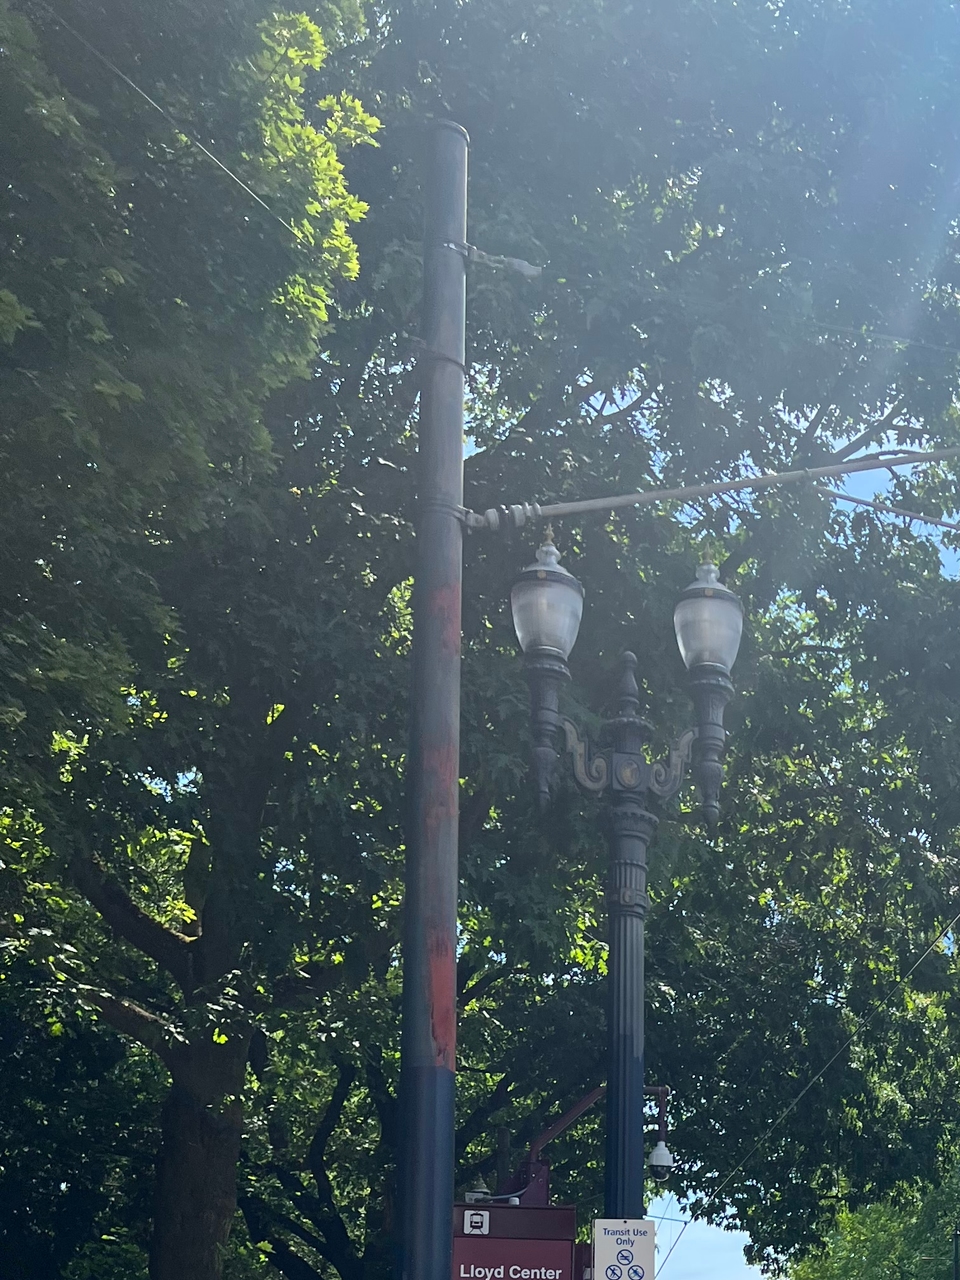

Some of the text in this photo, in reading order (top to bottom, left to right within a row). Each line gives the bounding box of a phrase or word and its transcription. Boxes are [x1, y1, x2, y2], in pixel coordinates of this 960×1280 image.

[602, 1227, 648, 1237] Transit Use
[616, 1237, 636, 1248] Only
[459, 1264, 562, 1280] Lloyd Center
